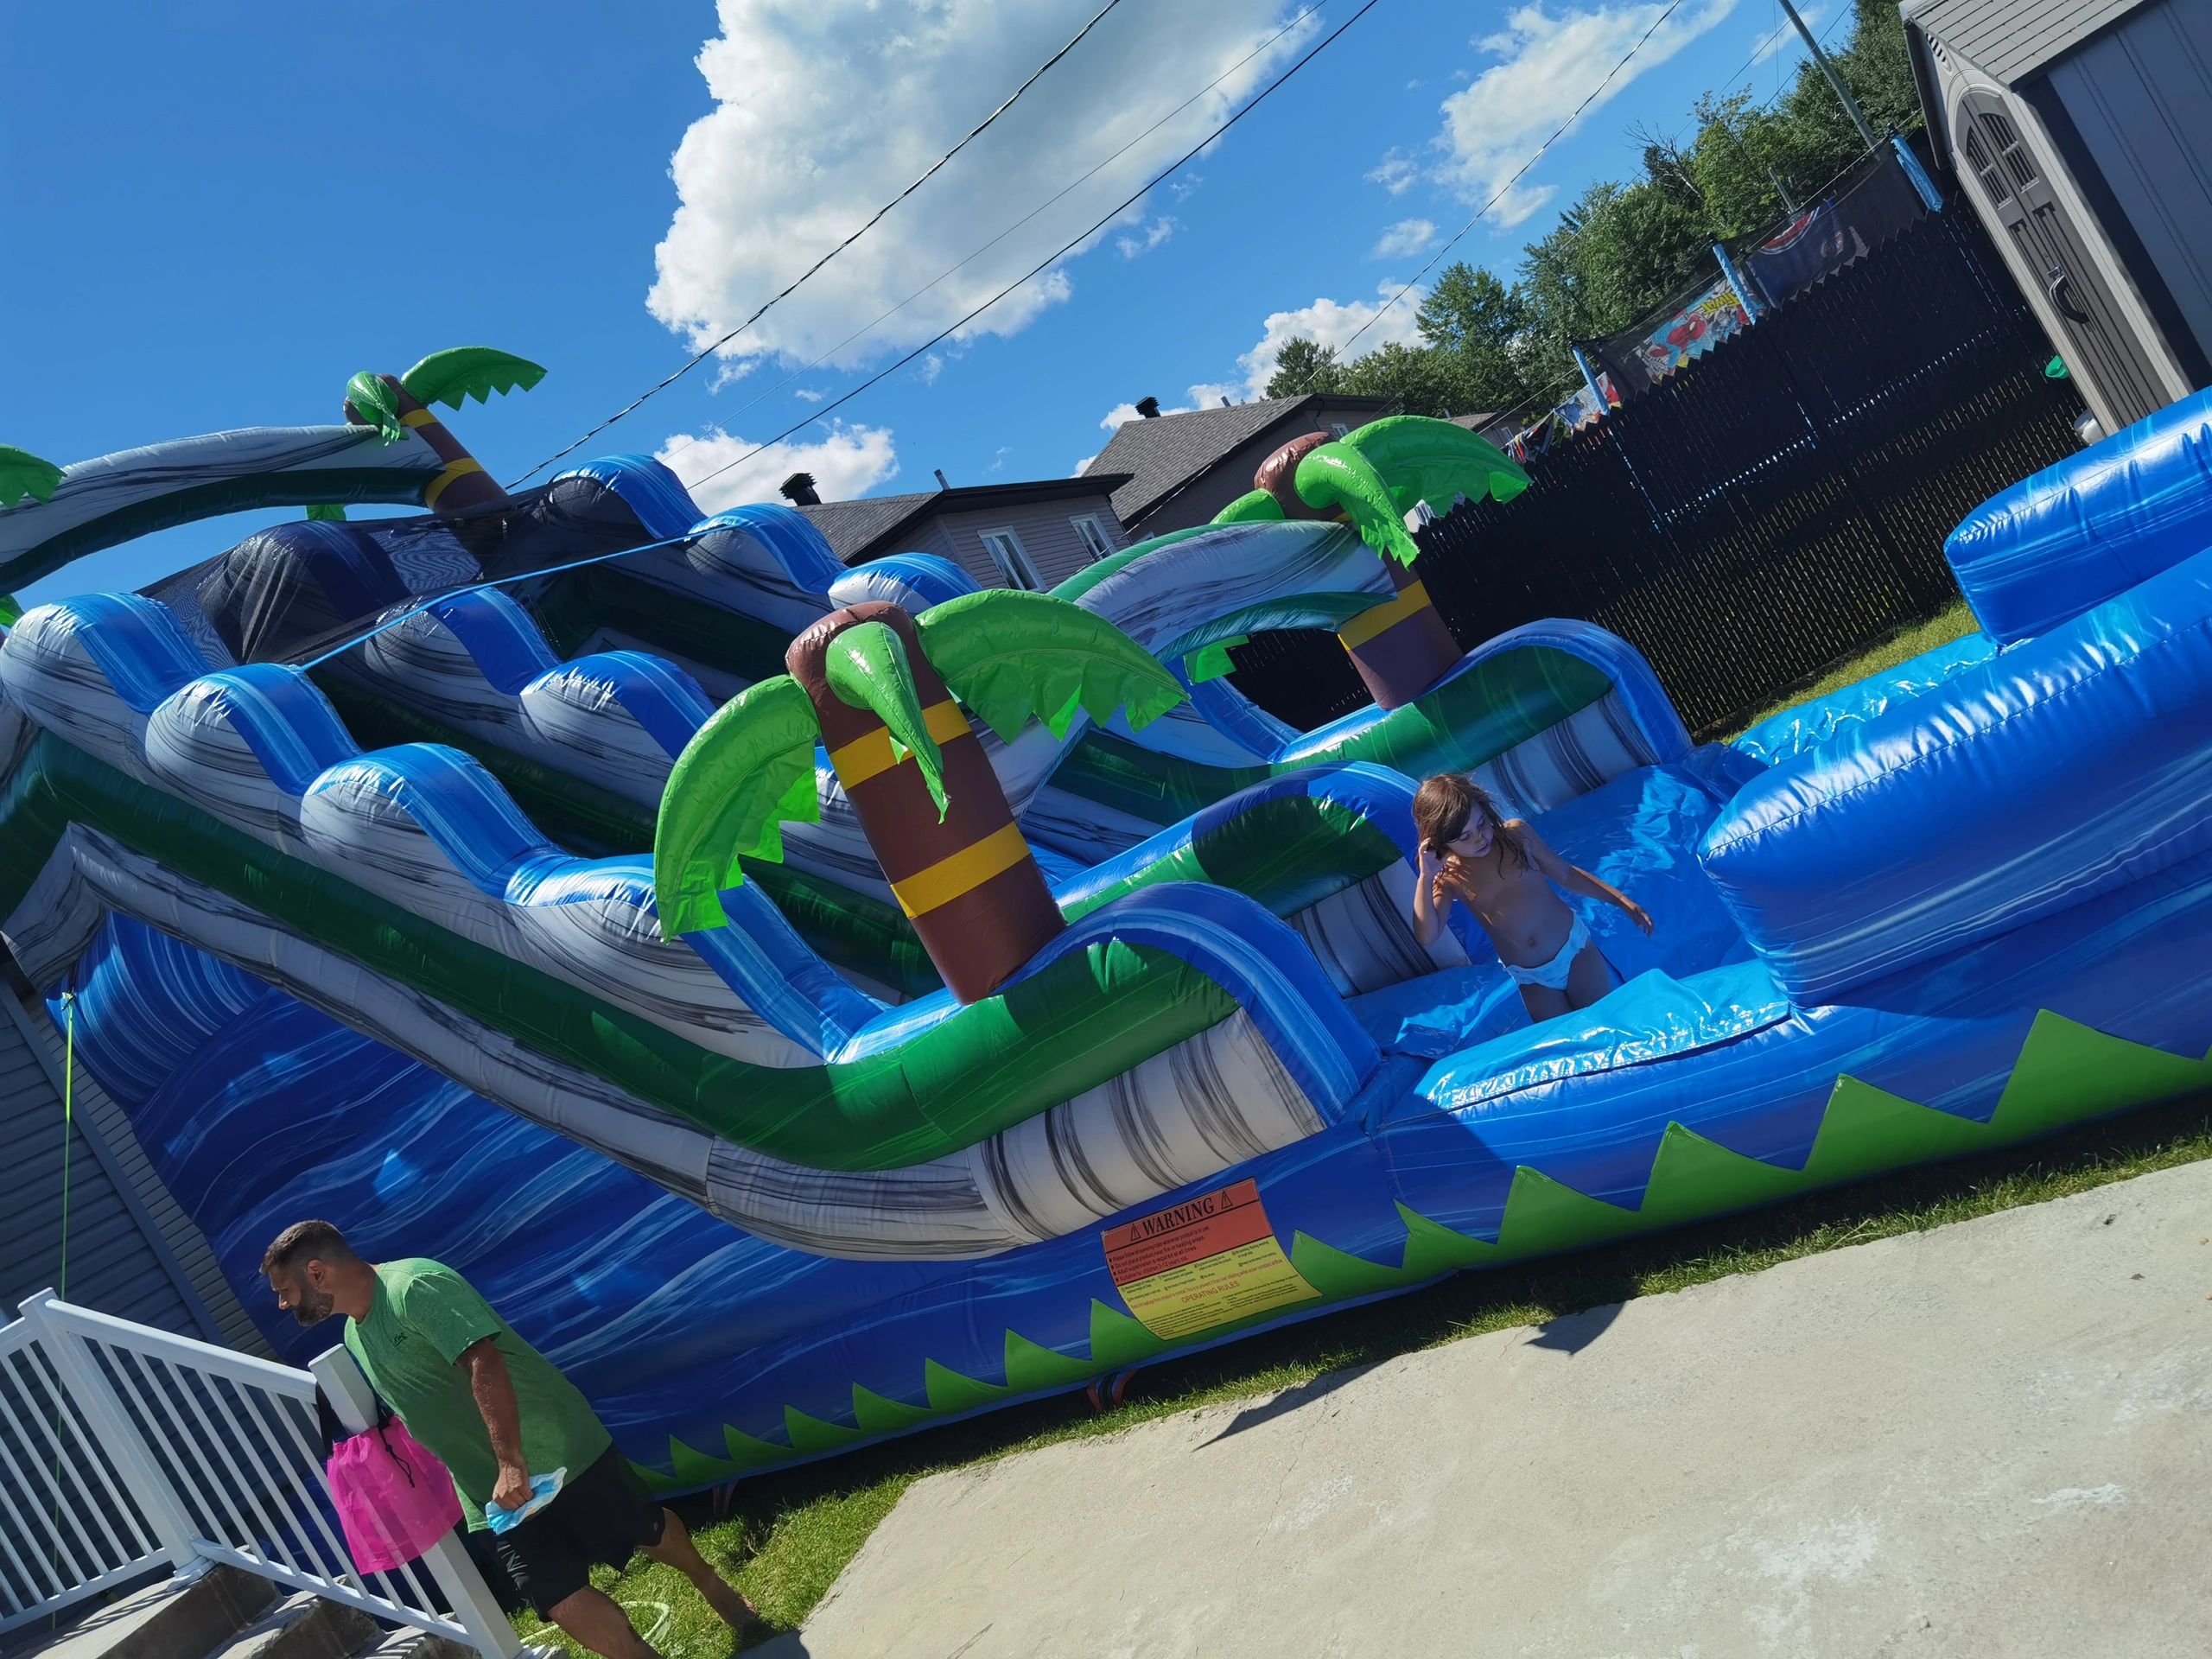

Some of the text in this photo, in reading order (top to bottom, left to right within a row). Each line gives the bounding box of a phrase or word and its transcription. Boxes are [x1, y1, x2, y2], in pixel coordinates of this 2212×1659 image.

[1142, 1198, 1215, 1236] WARNING
[1180, 1286, 1217, 1304] OPERATING
[1217, 1279, 1240, 1293] RULES
